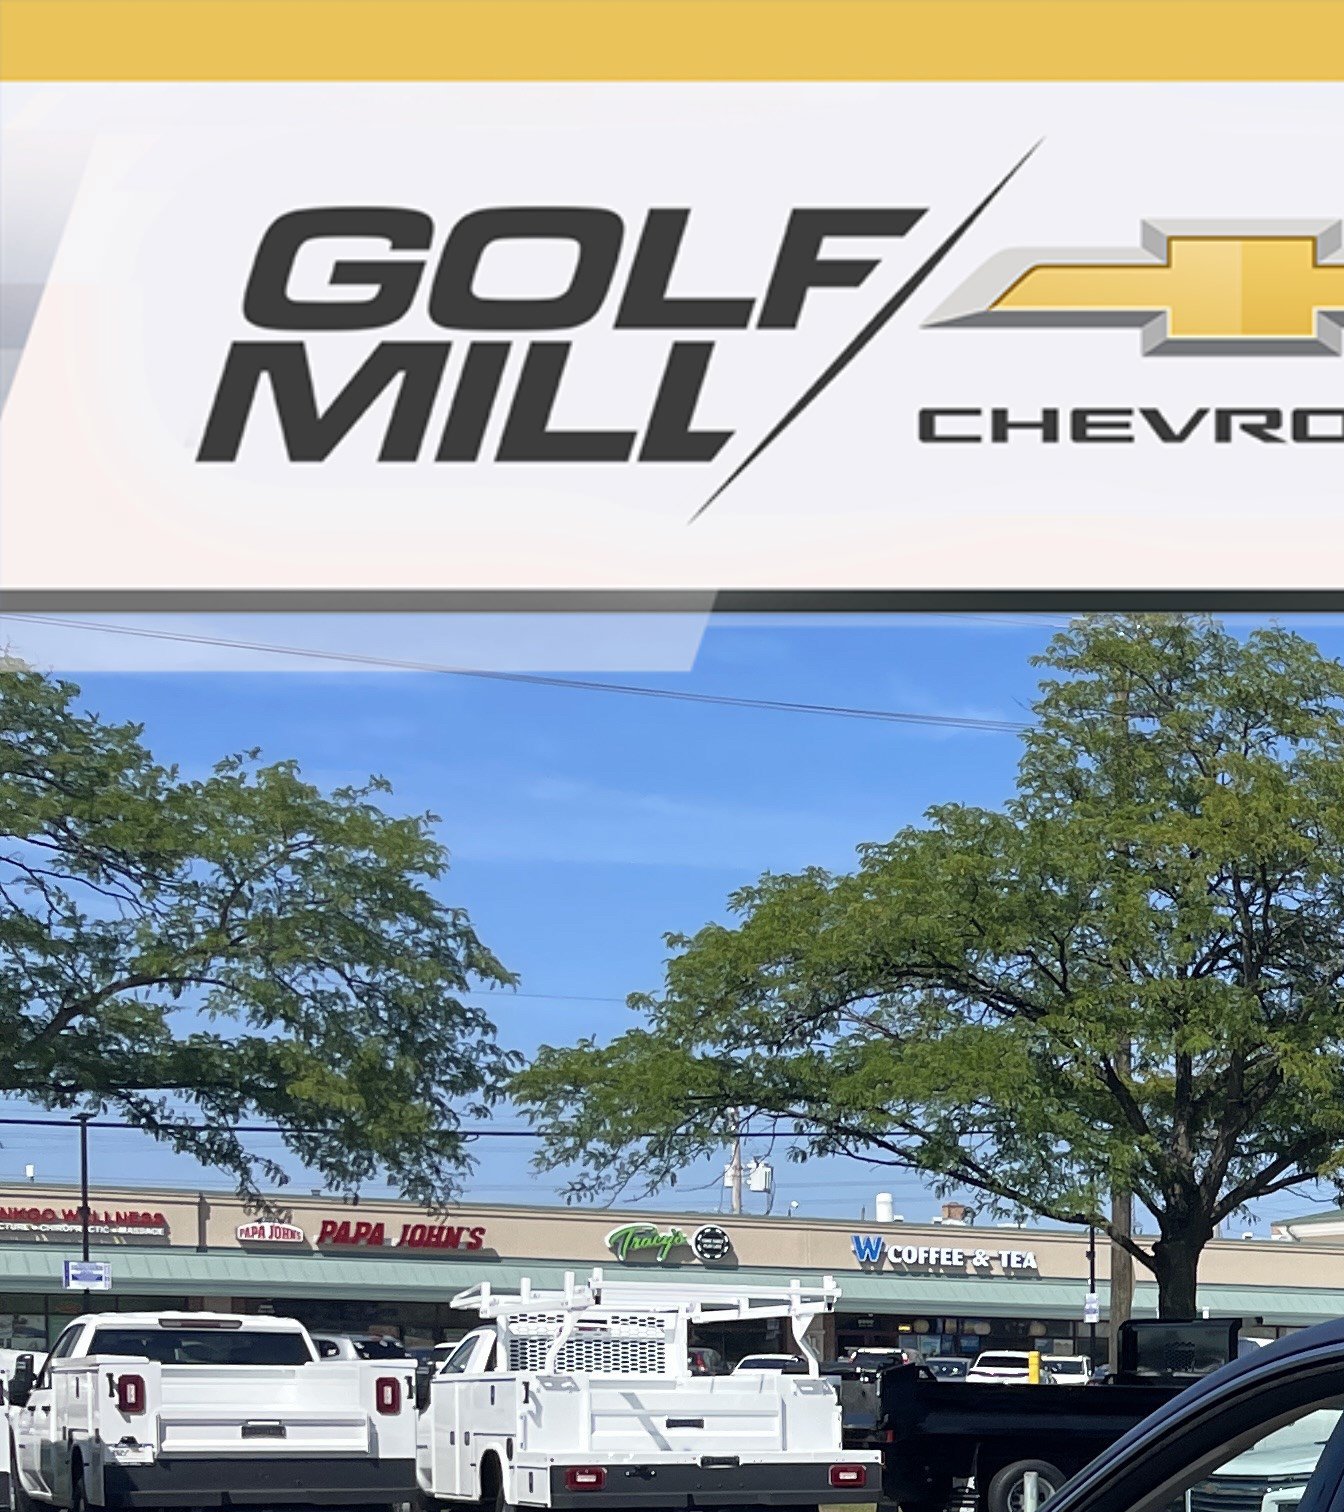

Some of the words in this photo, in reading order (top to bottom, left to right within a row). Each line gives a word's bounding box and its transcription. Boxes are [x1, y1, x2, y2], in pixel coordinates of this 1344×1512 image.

[61, 1208, 166, 1226] WLLNESS
[40, 1224, 110, 1233] CHIROPRCTIC
[239, 1225, 266, 1239] PAPA
[317, 1220, 385, 1246] PAPA
[397, 1224, 487, 1250] JOHN'S
[852, 1235, 884, 1263] W
[886, 1245, 965, 1267] COFFEE
[971, 1248, 990, 1268] &
[998, 1249, 1038, 1270] TEA
